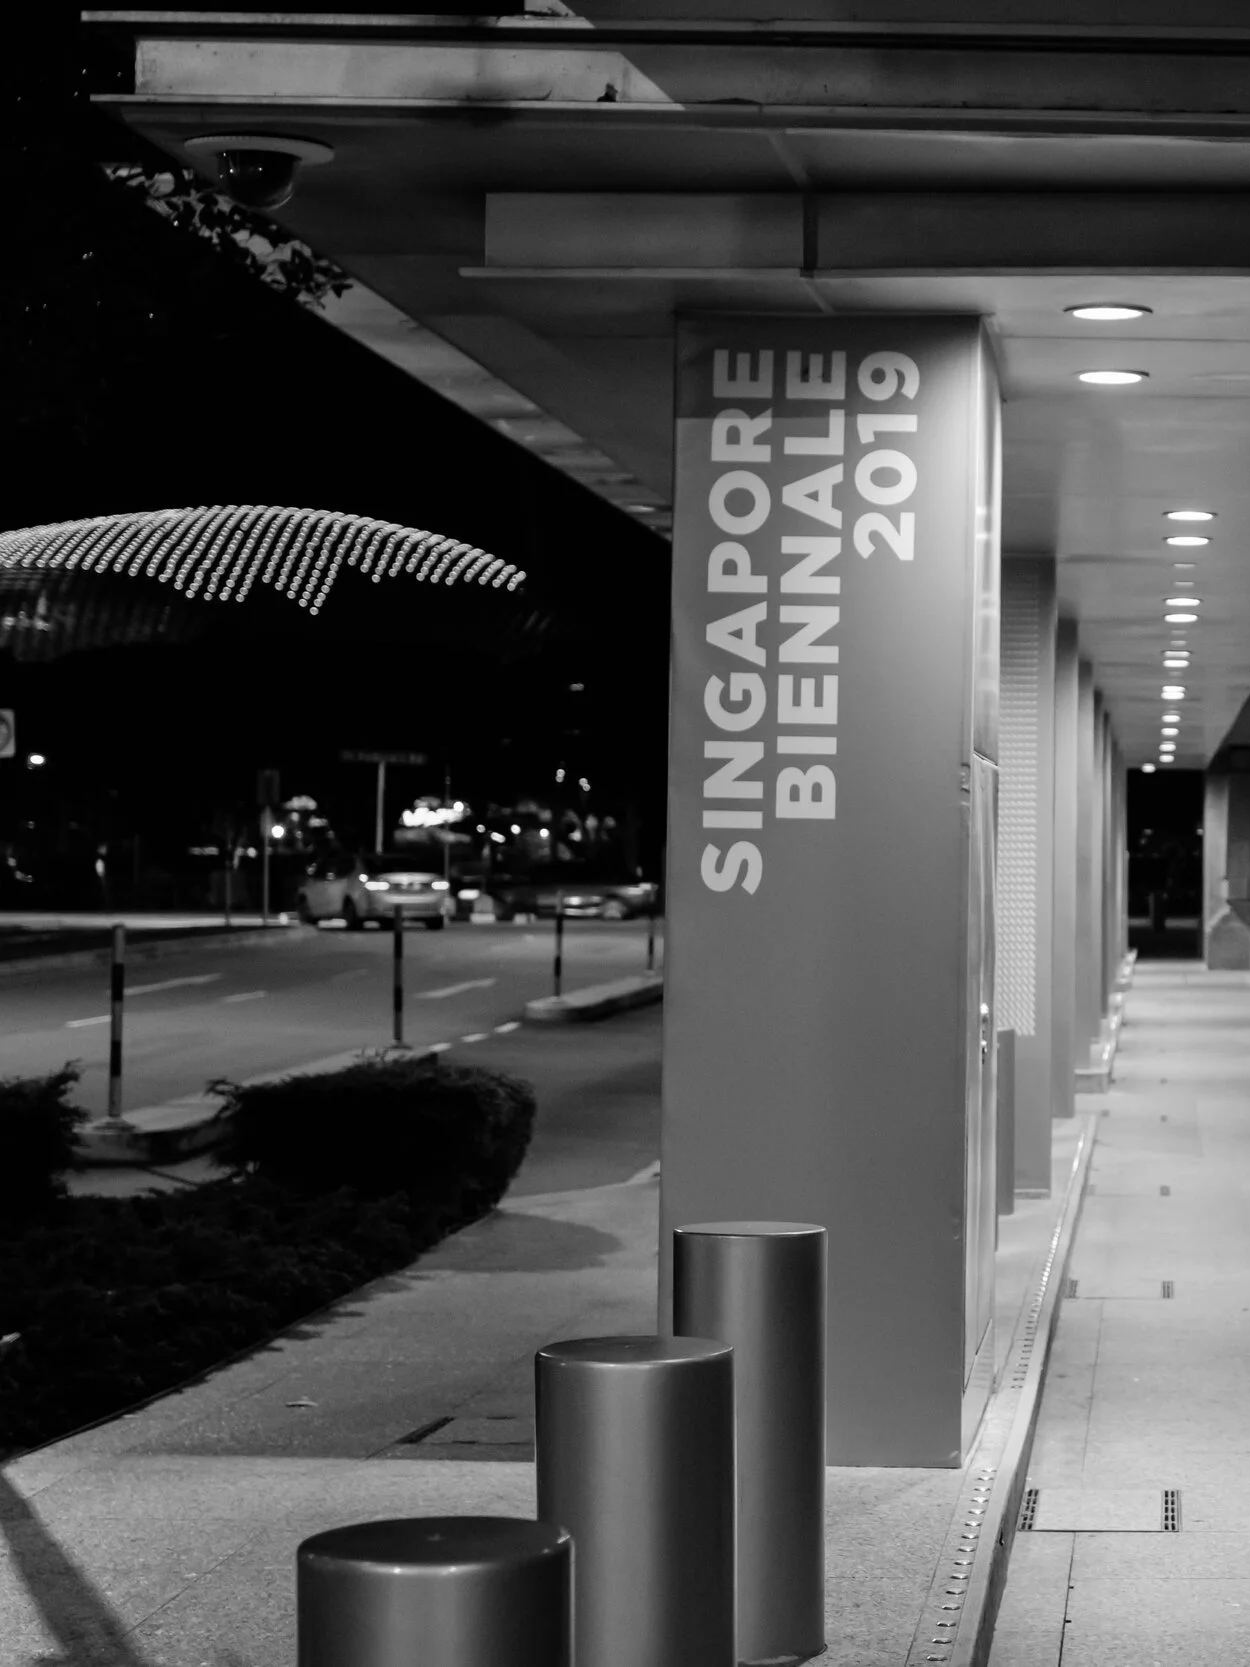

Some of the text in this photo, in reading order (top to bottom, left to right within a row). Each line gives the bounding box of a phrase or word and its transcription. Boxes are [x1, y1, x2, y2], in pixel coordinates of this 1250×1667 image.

[700, 349, 774, 894] SINGAPORE
[775, 350, 847, 820] BIENNALE
[853, 351, 921, 561] 2019
